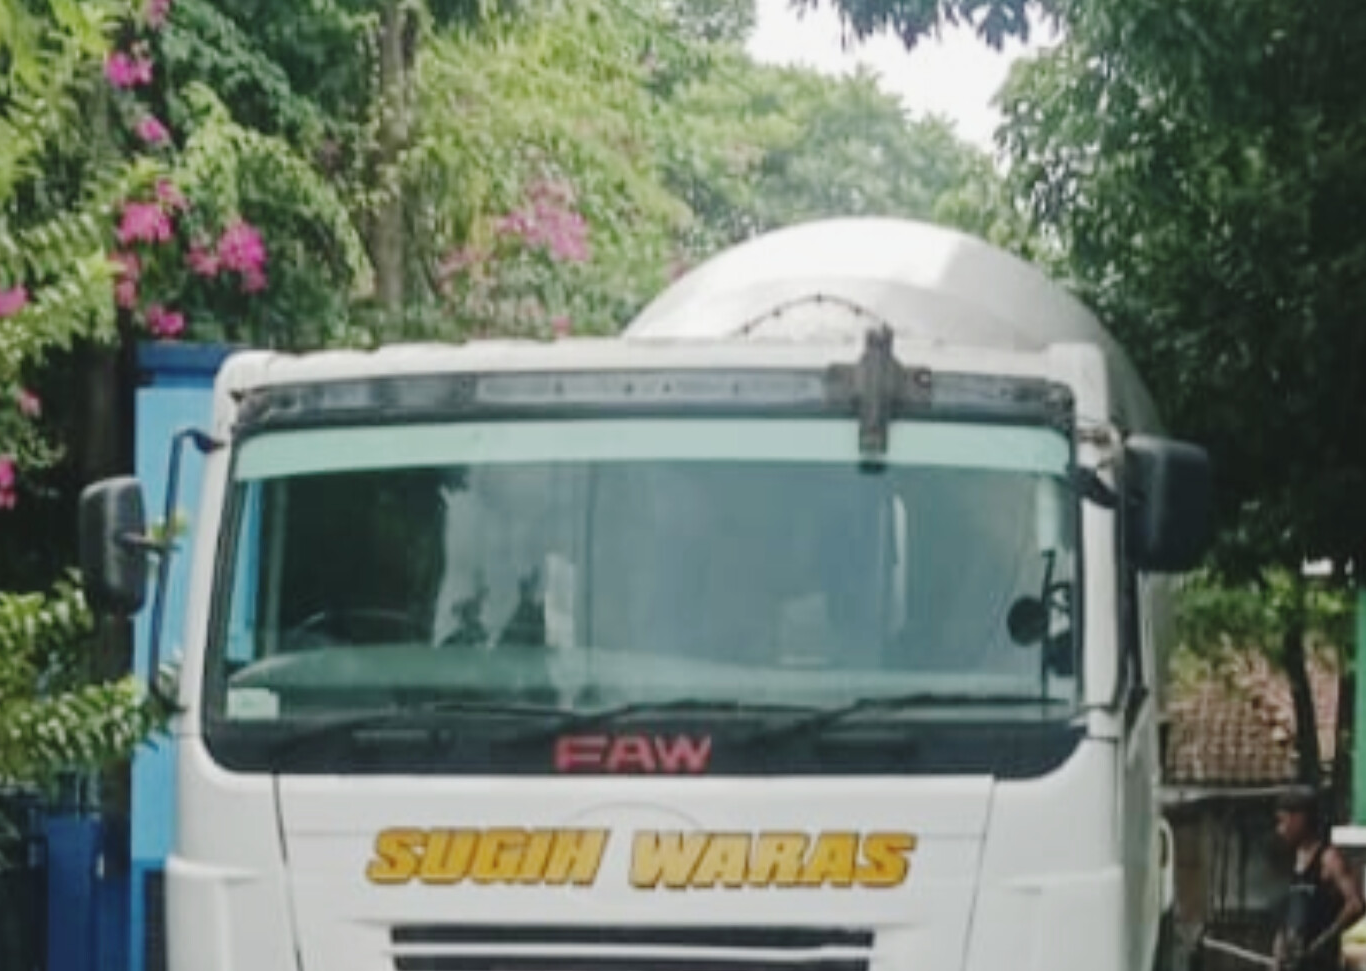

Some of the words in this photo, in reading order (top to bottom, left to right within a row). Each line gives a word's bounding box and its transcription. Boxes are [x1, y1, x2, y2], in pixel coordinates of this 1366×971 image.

[554, 735, 712, 772] FAW
[366, 828, 611, 886] SUGIH
[628, 830, 917, 889] WARAS
